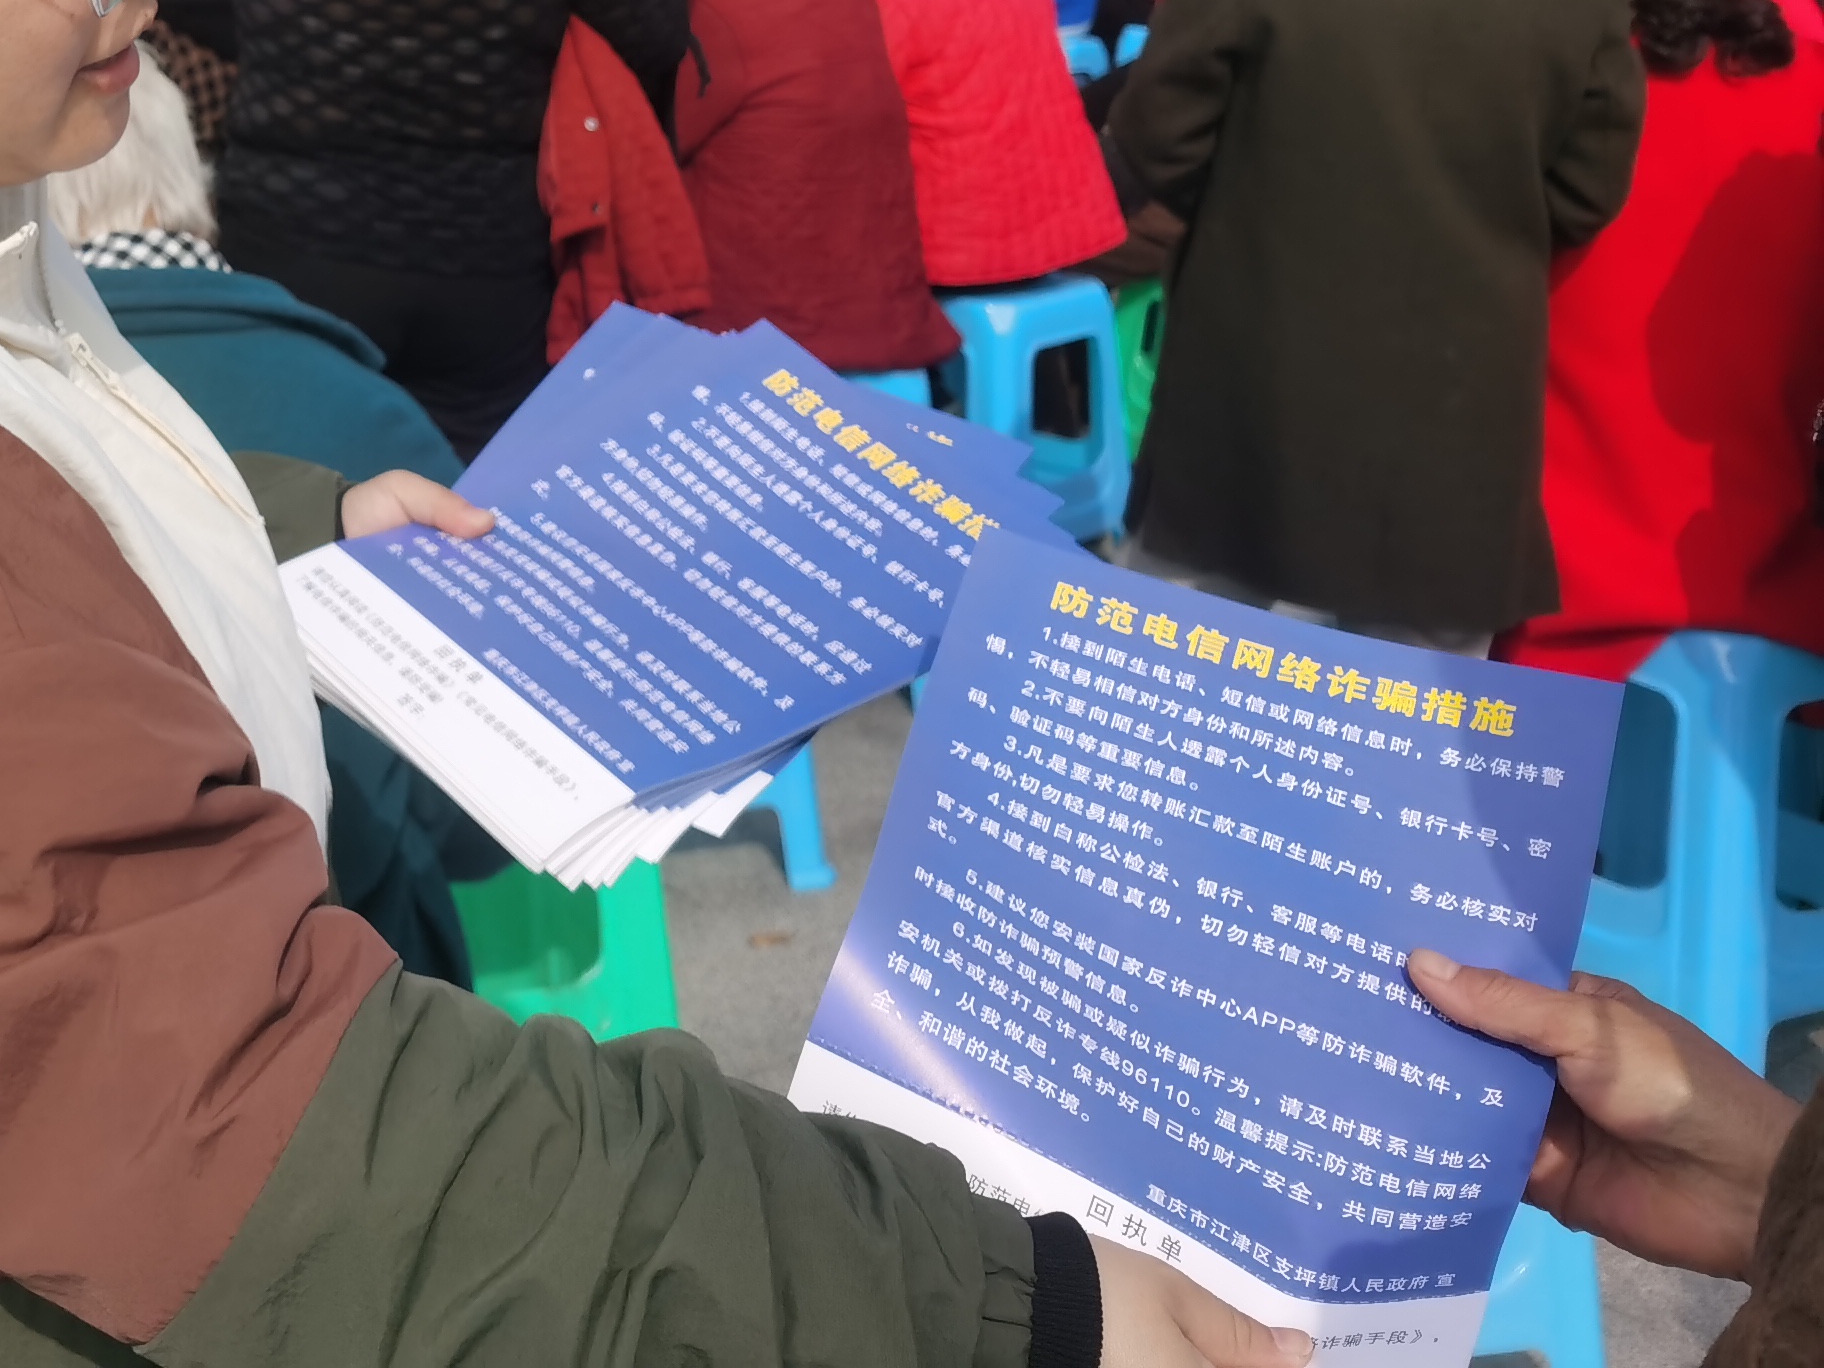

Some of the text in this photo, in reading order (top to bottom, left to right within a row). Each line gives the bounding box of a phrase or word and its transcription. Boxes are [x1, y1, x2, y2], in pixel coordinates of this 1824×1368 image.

[1050, 581, 1517, 738] 防范电信网络诈骗措施
[927, 816, 957, 844] 式。
[936, 790, 1451, 1023] 官方渠道核实信息真伪，切勿轻信对方提供的
[969, 1174, 1043, 1216] 防范电
[1086, 1194, 1183, 1264] 回执单
